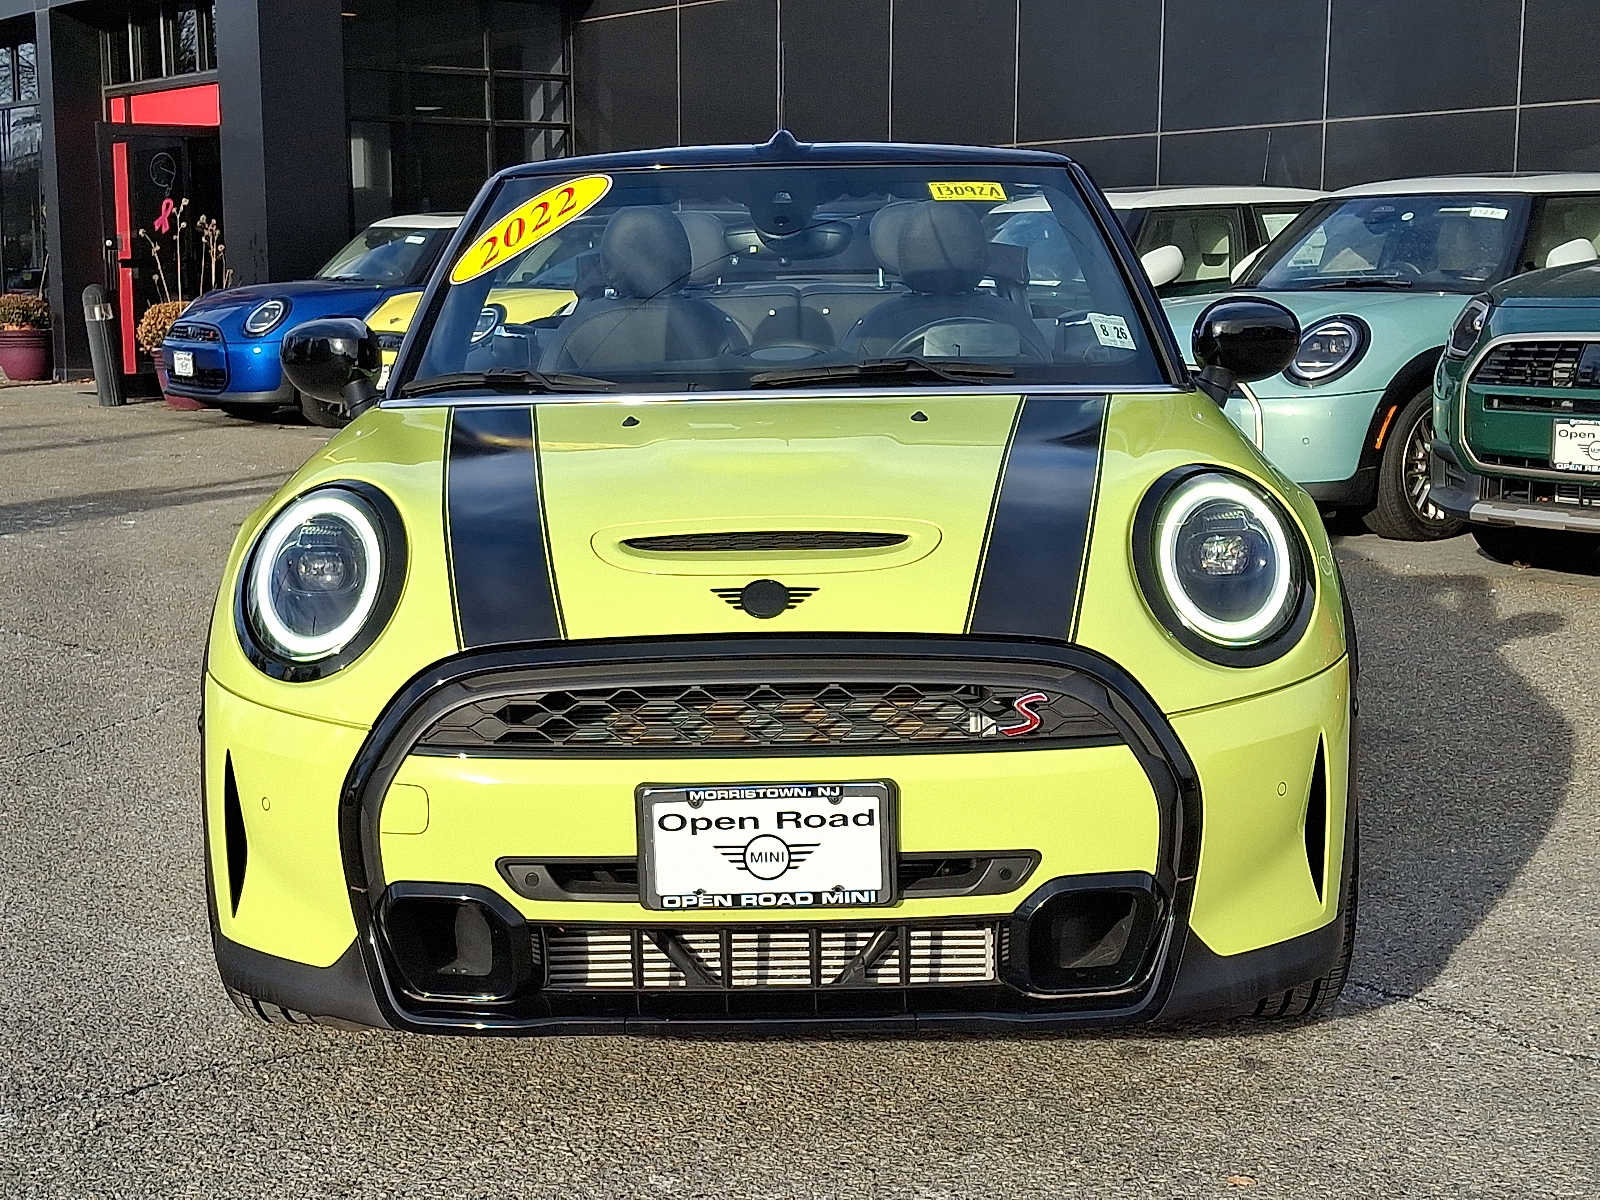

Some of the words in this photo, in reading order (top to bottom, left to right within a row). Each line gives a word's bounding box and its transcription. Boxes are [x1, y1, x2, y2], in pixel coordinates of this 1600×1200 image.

[480, 187, 577, 269] 2022
[1100, 324, 1109, 337] 8
[1113, 326, 1128, 340] 26
[1558, 429, 1595, 440] Open
[998, 692, 1048, 736] S
[689, 788, 812, 800] MORRISTOWN,
[818, 786, 841, 797] NJ
[658, 813, 760, 835] Open
[776, 809, 875, 829] Road
[750, 851, 786, 864] MINI
[662, 894, 733, 908] OPEN
[740, 892, 814, 906] ROAD
[821, 890, 878, 905] MINI
